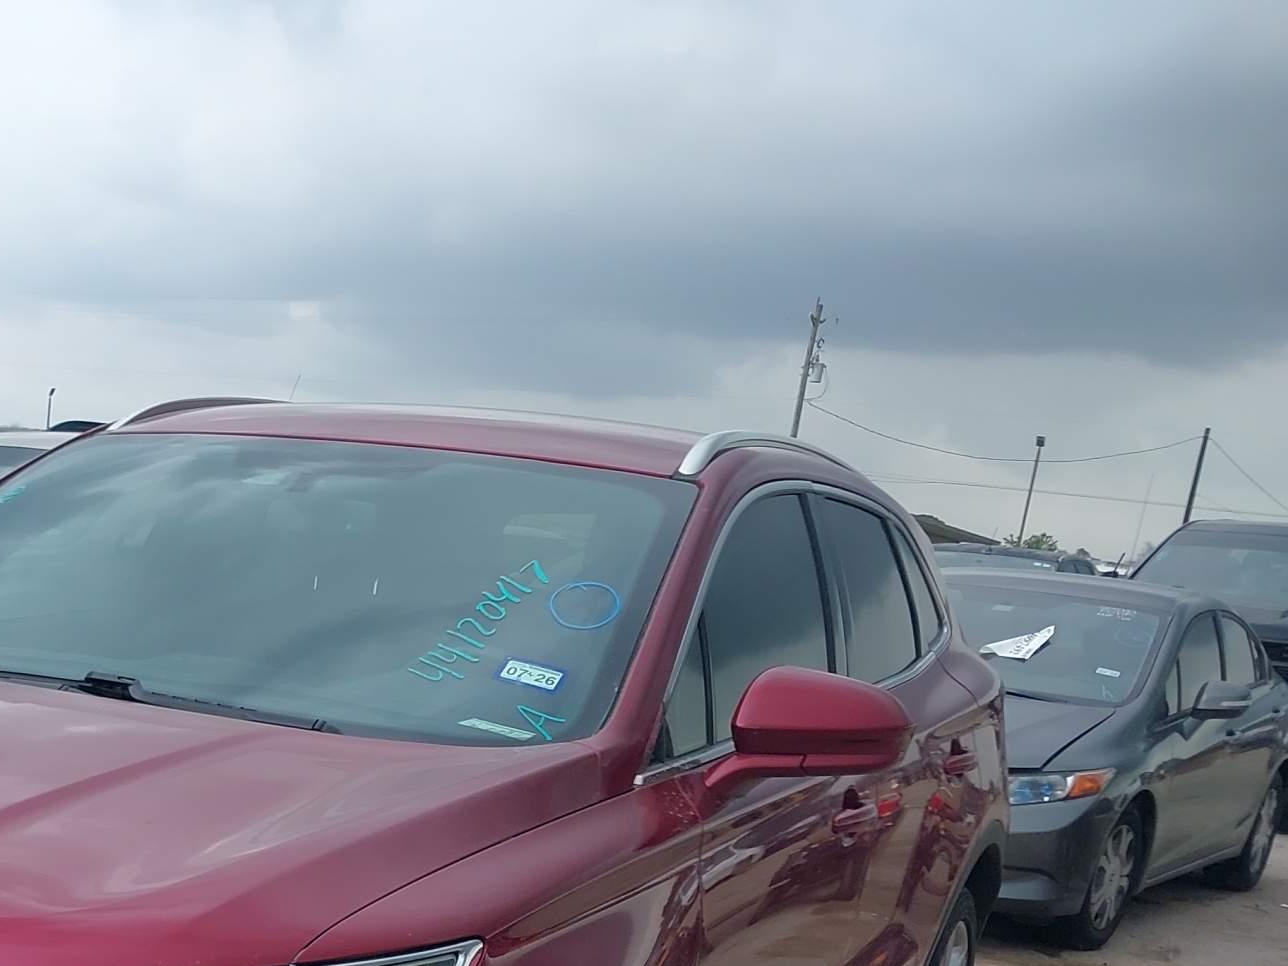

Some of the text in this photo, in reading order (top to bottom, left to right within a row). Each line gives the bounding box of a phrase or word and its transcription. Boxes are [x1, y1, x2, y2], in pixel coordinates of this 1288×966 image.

[408, 559, 549, 681] 44120417
[506, 666, 557, 686] 07 26
[517, 704, 567, 741] A
